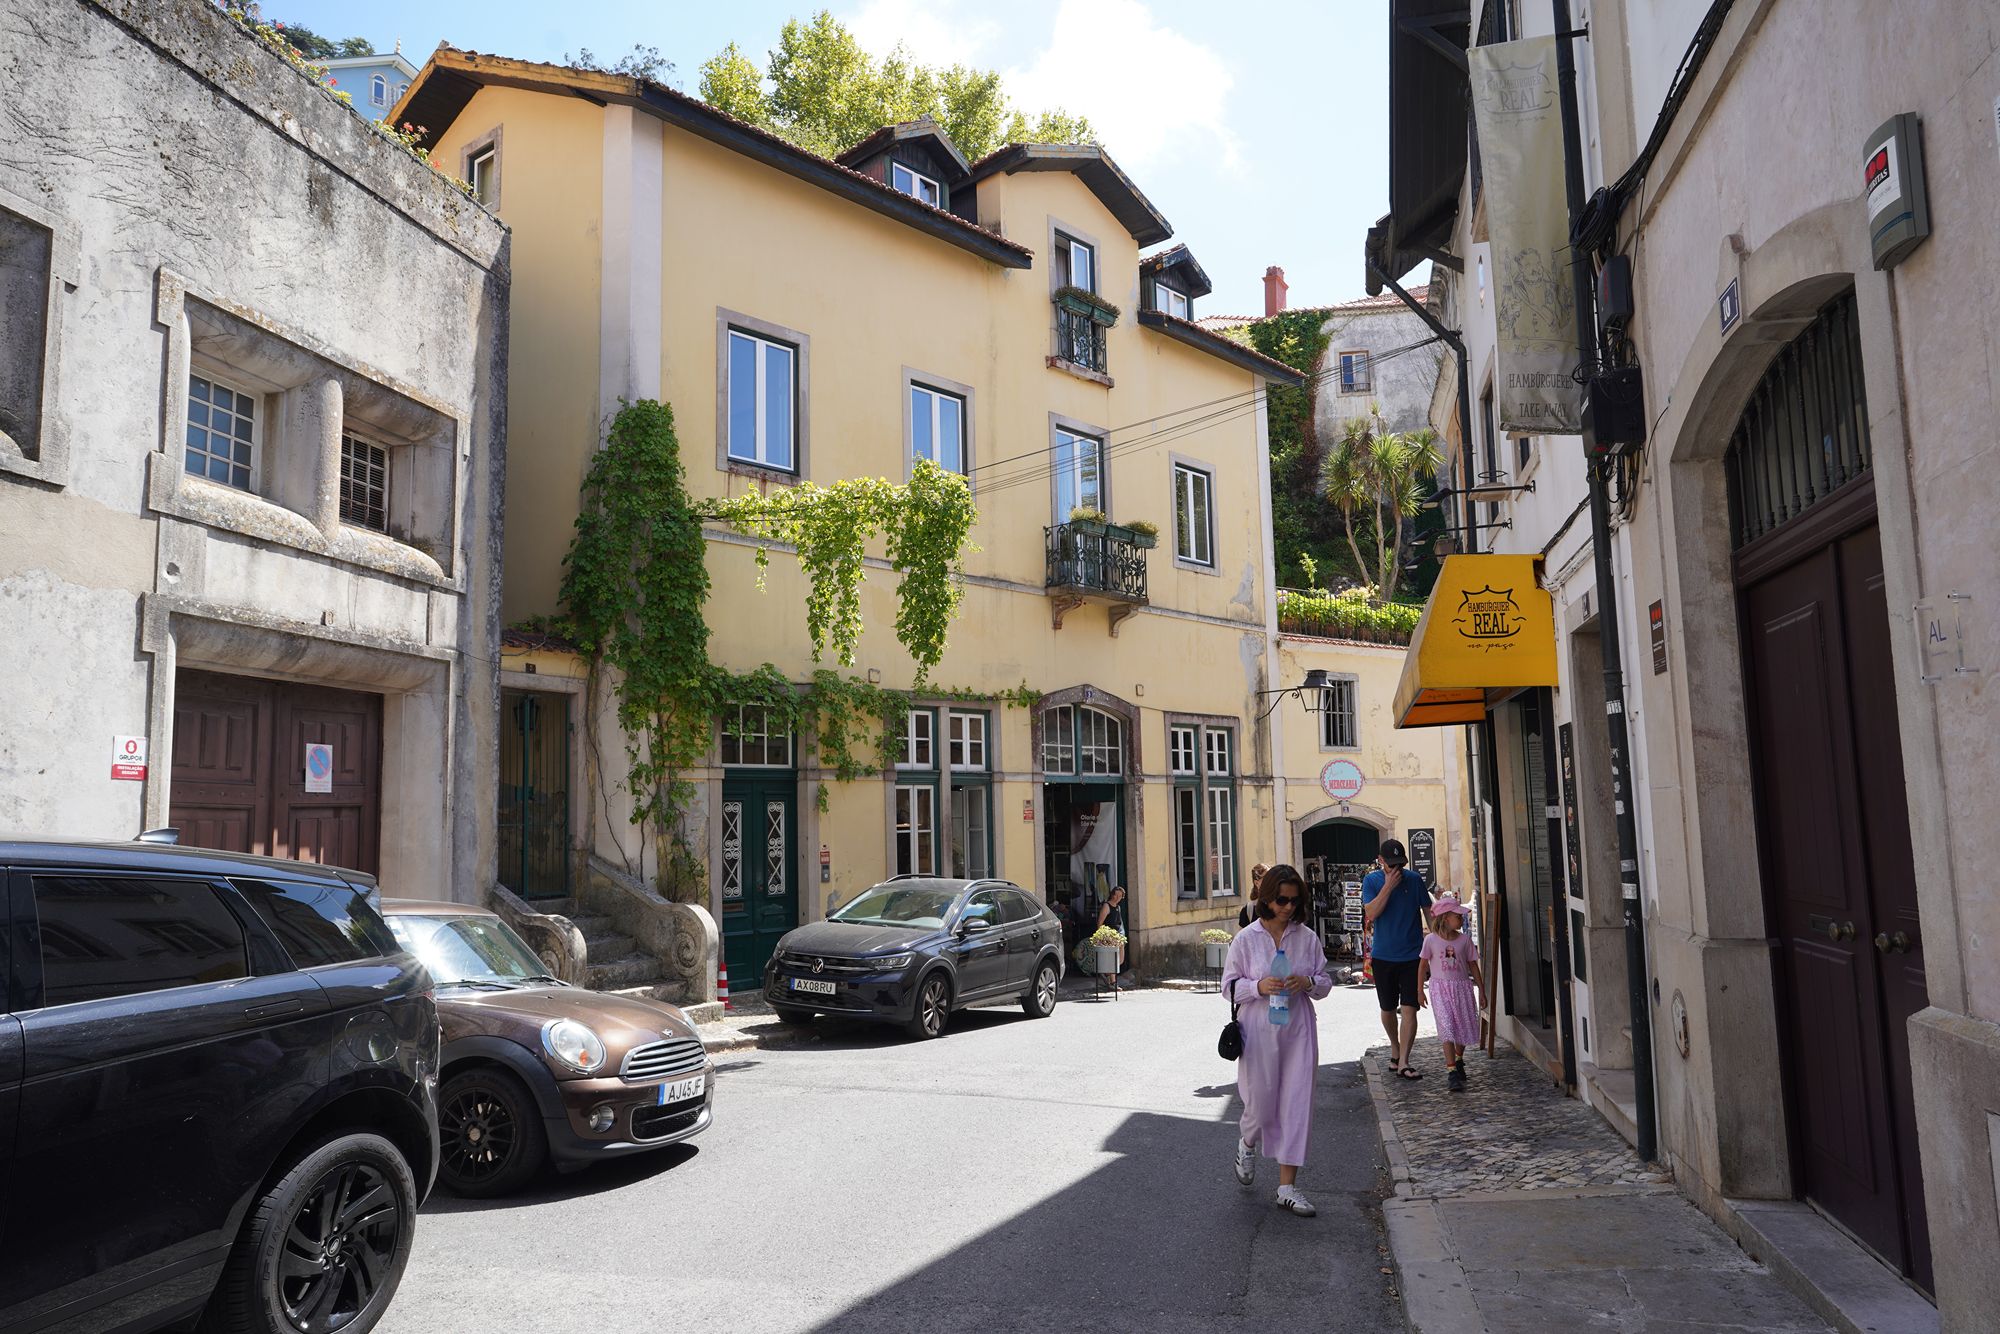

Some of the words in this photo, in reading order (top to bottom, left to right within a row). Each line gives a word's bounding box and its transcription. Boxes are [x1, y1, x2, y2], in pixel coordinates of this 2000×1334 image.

[1500, 88, 1540, 111] REAL
[1519, 403, 1540, 417] TAKE
[1543, 402, 1567, 417] AWAY
[1473, 612, 1509, 635] REAL
[796, 980, 833, 993] AX08RU
[667, 1078, 702, 1102] AJ45JF
